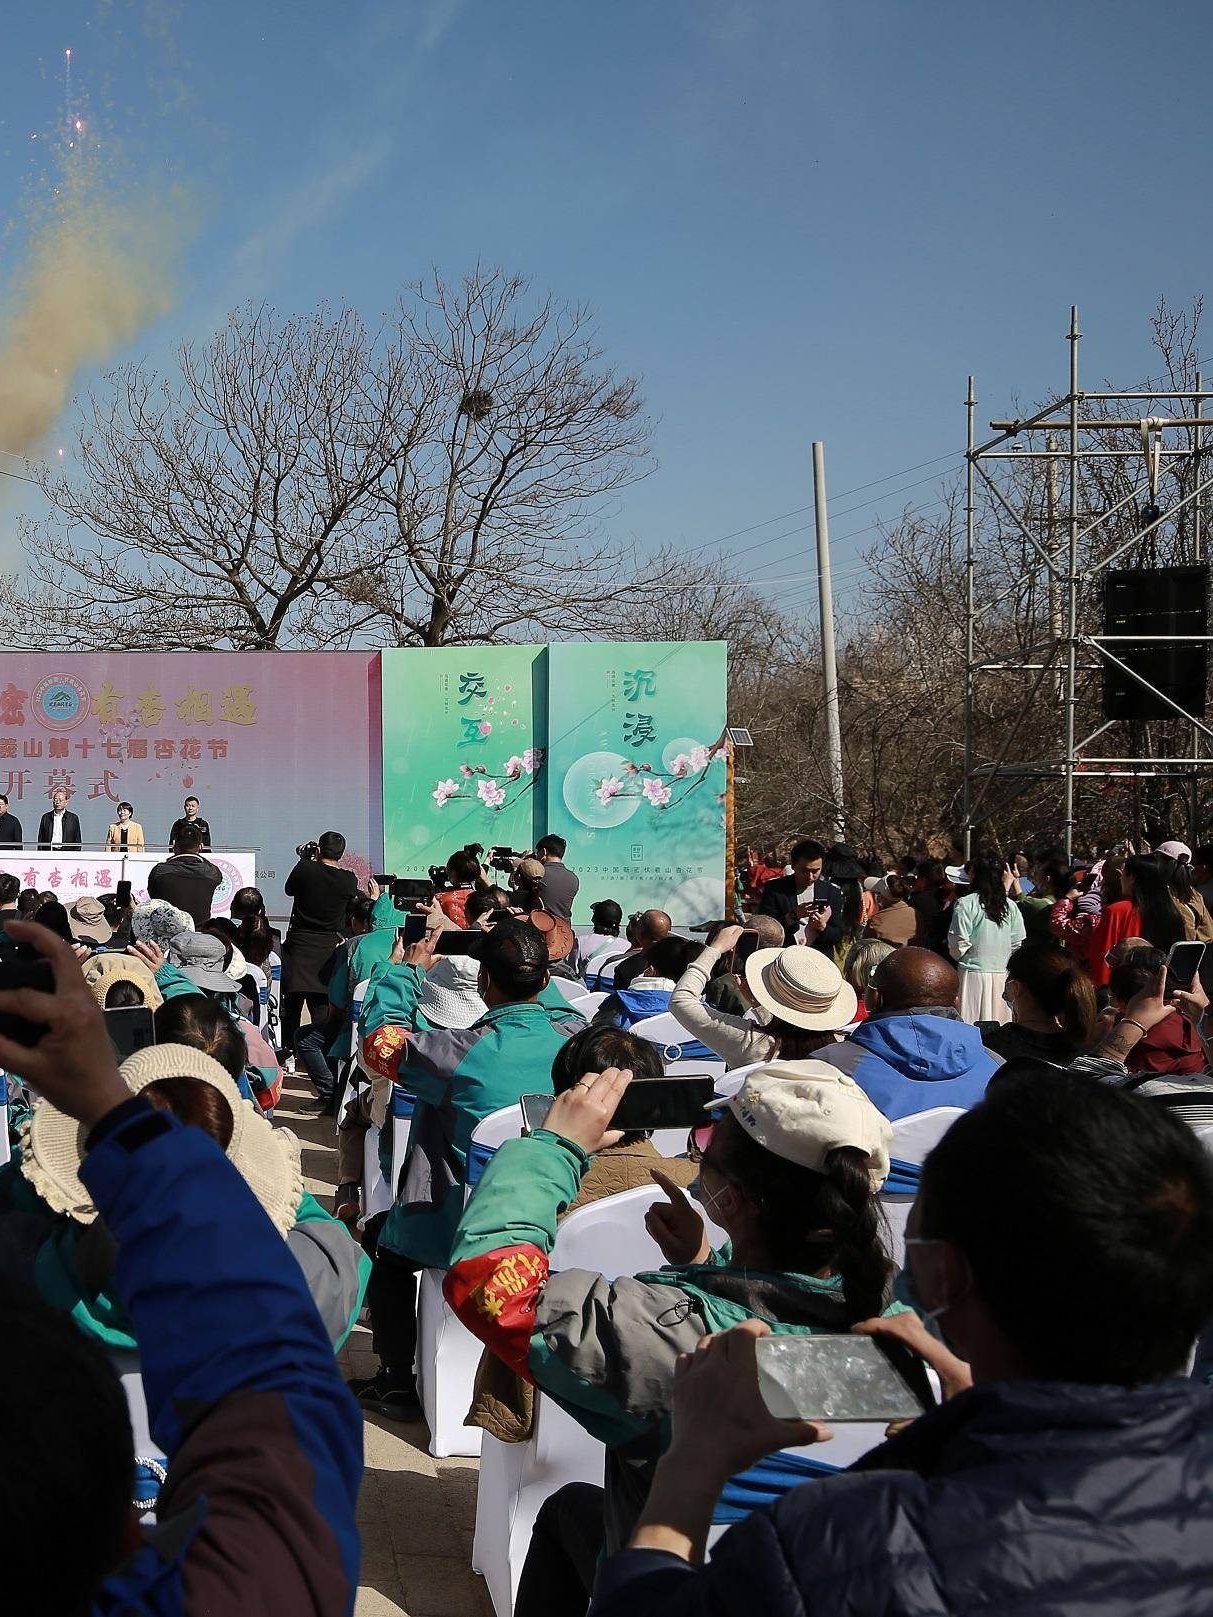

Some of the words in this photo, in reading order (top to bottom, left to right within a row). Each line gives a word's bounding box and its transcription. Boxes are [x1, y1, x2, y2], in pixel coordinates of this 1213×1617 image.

[90, 681, 258, 727] 有杏相遇
[623, 669, 657, 747] 沉浸
[21, 866, 113, 889] 有杏相遇
